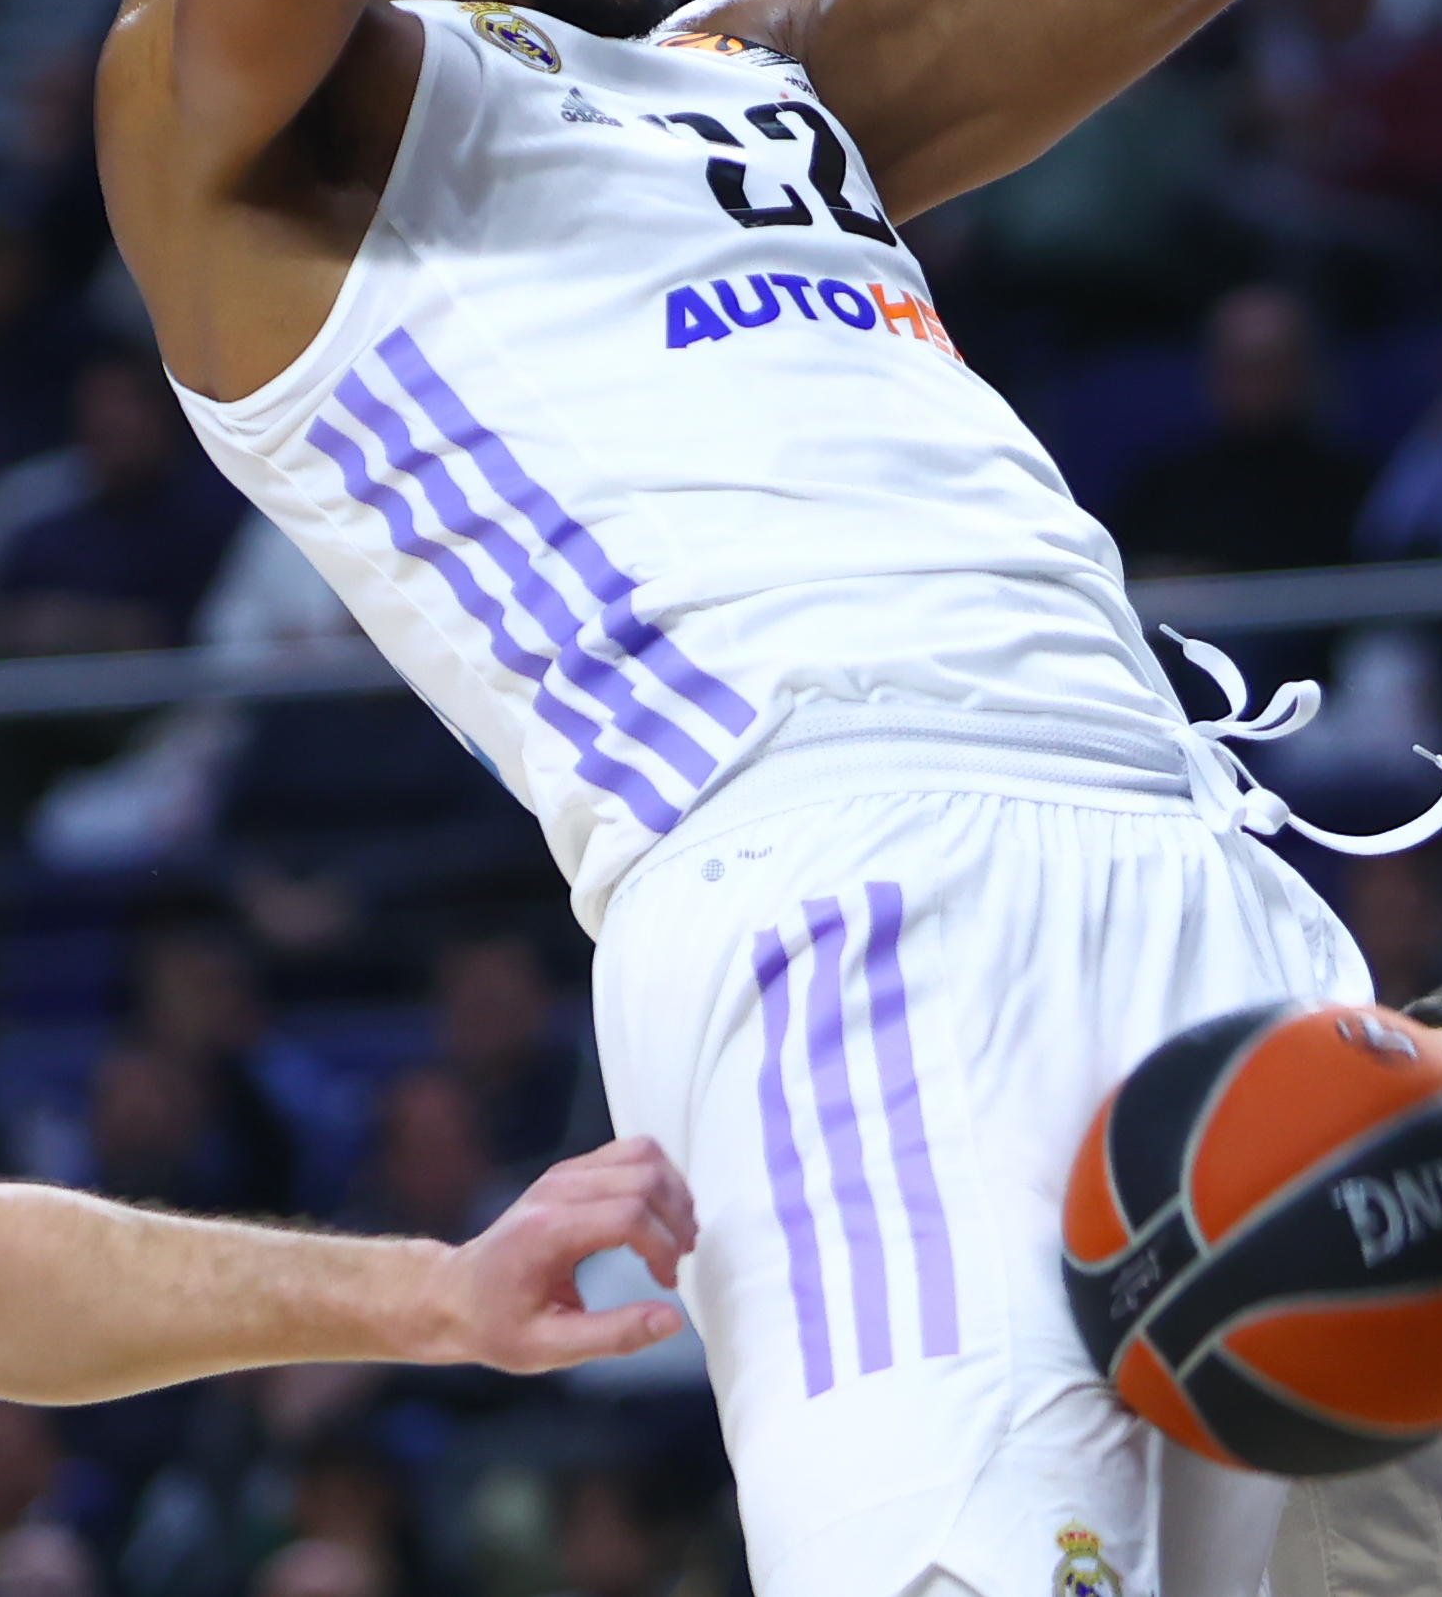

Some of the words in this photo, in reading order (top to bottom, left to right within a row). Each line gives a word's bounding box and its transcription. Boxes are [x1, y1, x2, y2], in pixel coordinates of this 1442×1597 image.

[560, 110, 624, 128] adidas
[638, 100, 898, 247] 22
[665, 273, 964, 365] AUTOHE
